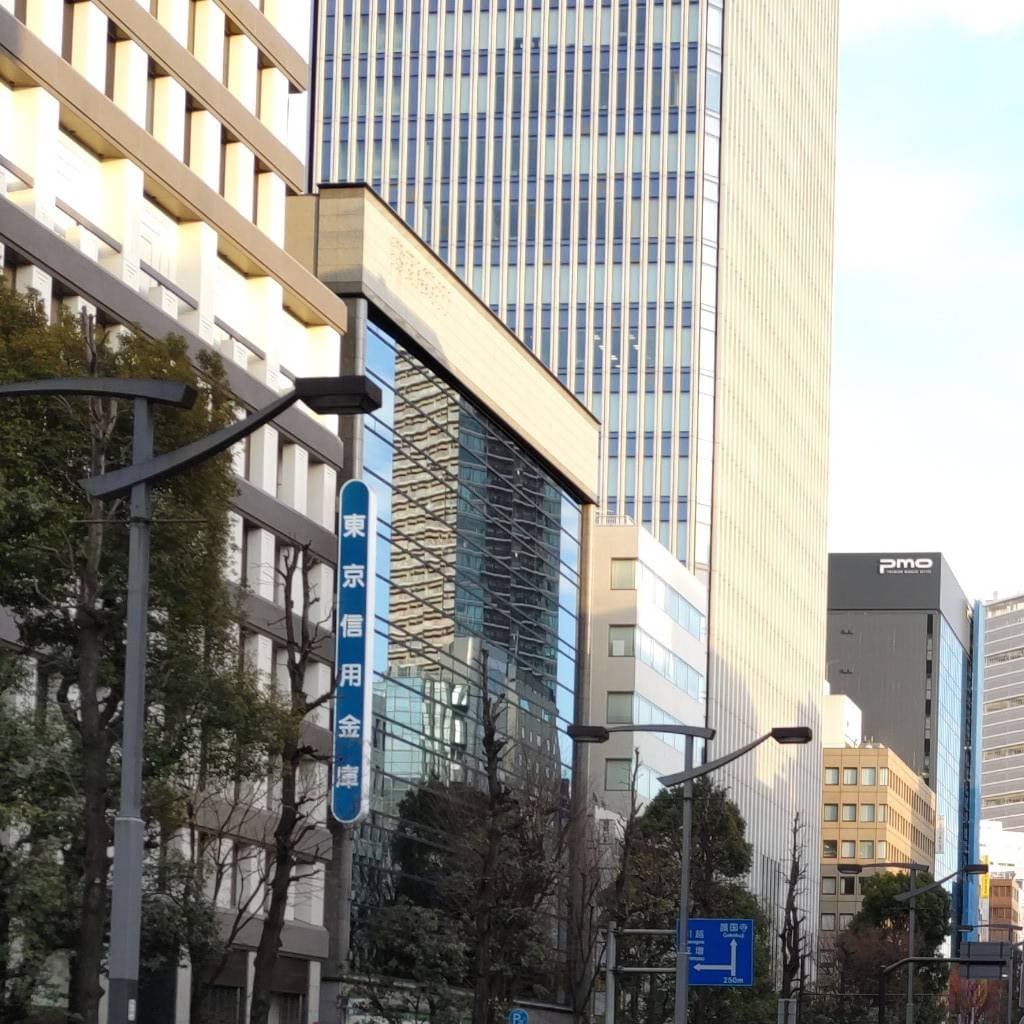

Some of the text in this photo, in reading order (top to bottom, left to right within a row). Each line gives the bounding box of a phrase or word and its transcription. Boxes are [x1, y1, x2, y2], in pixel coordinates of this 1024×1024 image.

[336, 513, 365, 789] 東京信用金庫
